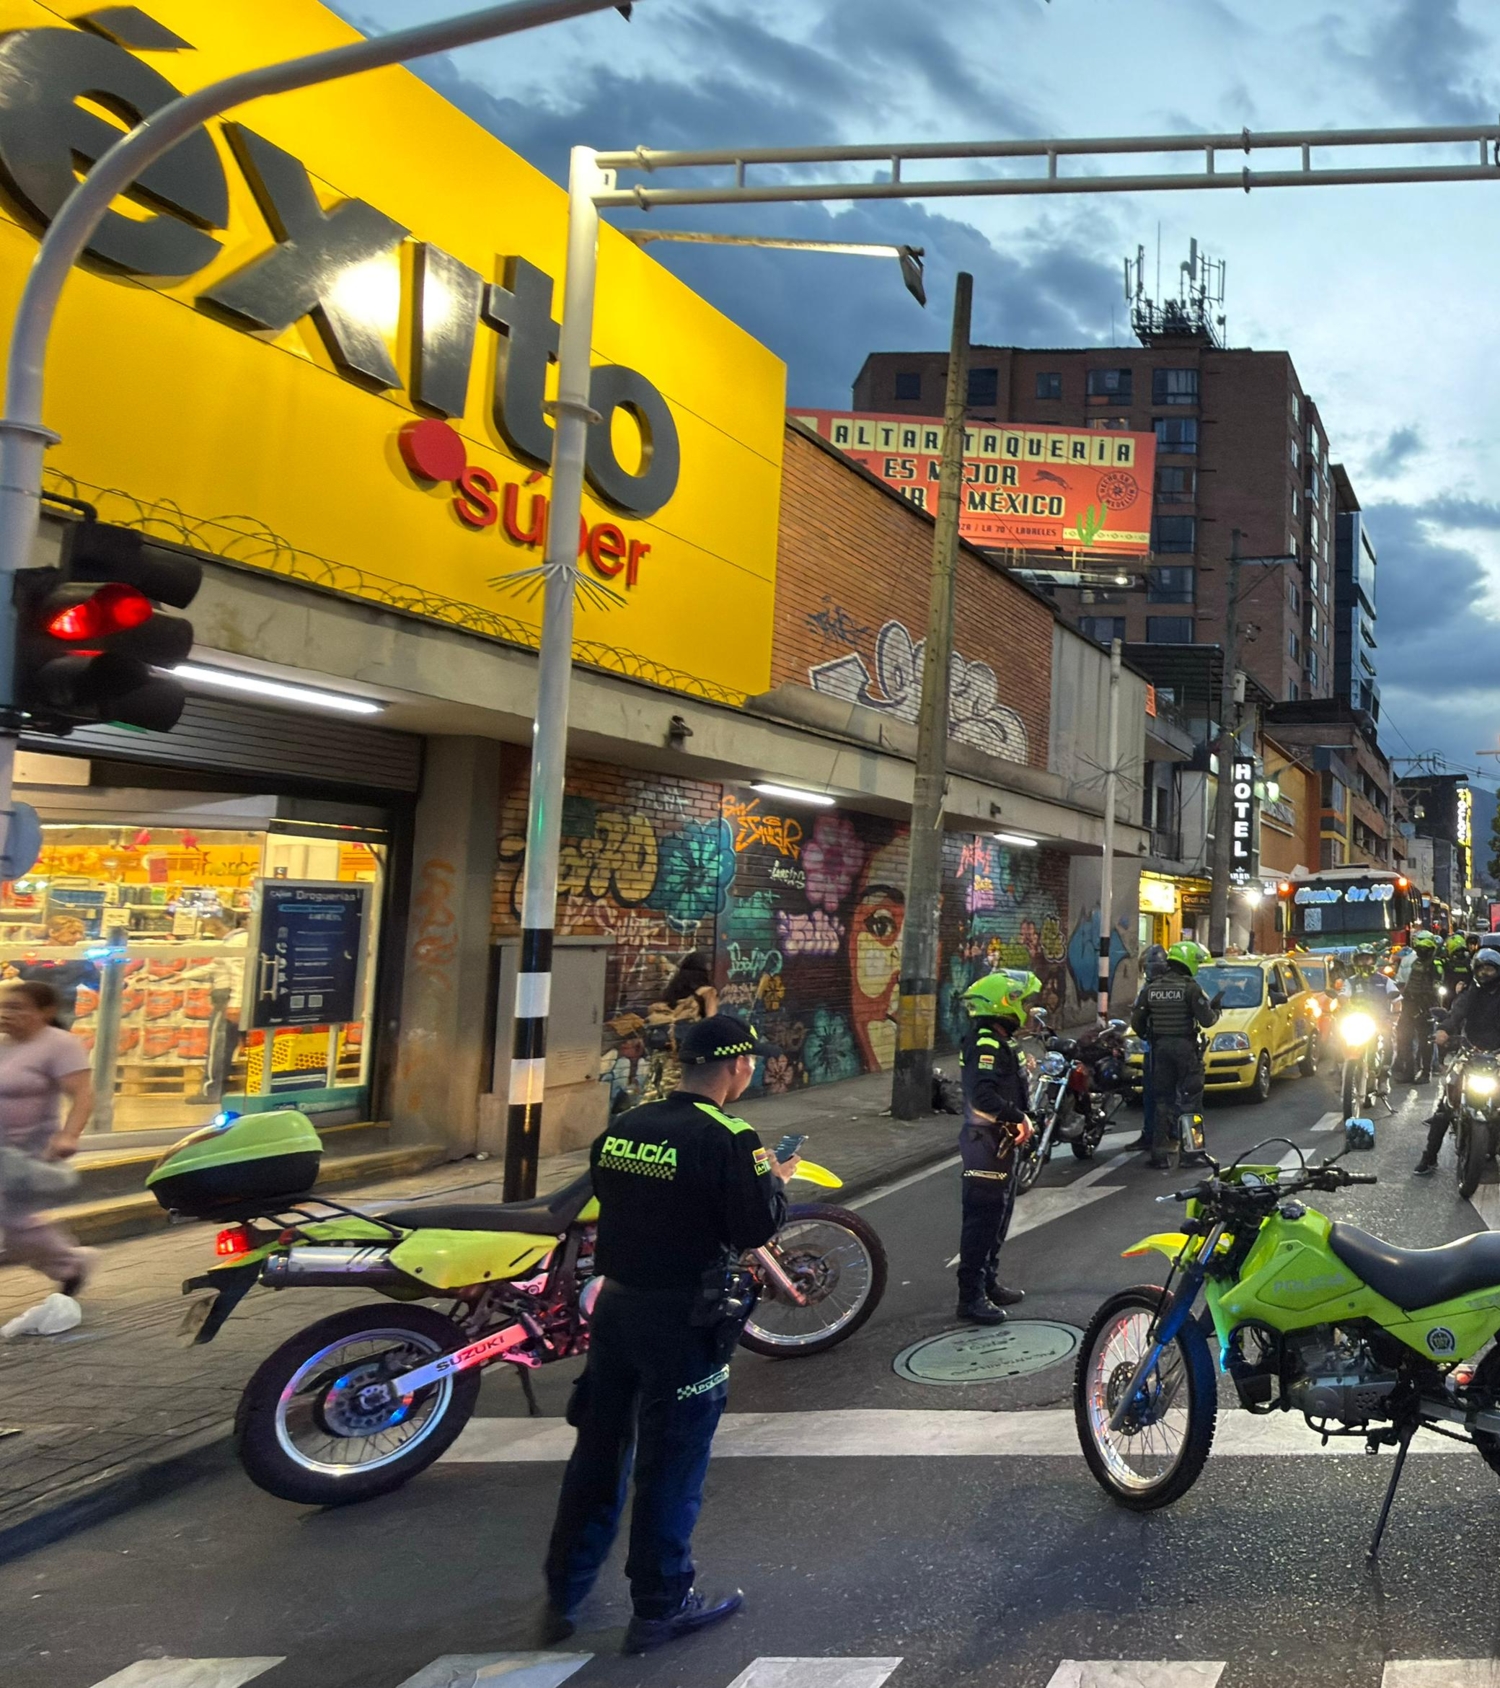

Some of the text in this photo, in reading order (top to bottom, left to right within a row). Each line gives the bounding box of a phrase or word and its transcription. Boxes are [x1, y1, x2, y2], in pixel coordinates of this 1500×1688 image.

[0, 6, 681, 517] éxito
[835, 424, 938, 450] ALTAR
[884, 457, 915, 479] ES
[968, 487, 1063, 517] MÉXICO
[452, 466, 651, 586] súer
[1234, 764, 1251, 857] HOTEL
[1150, 990, 1181, 1000] POLICIA
[601, 1136, 677, 1167] POLICÍA
[436, 1336, 504, 1372] SUZUKI
